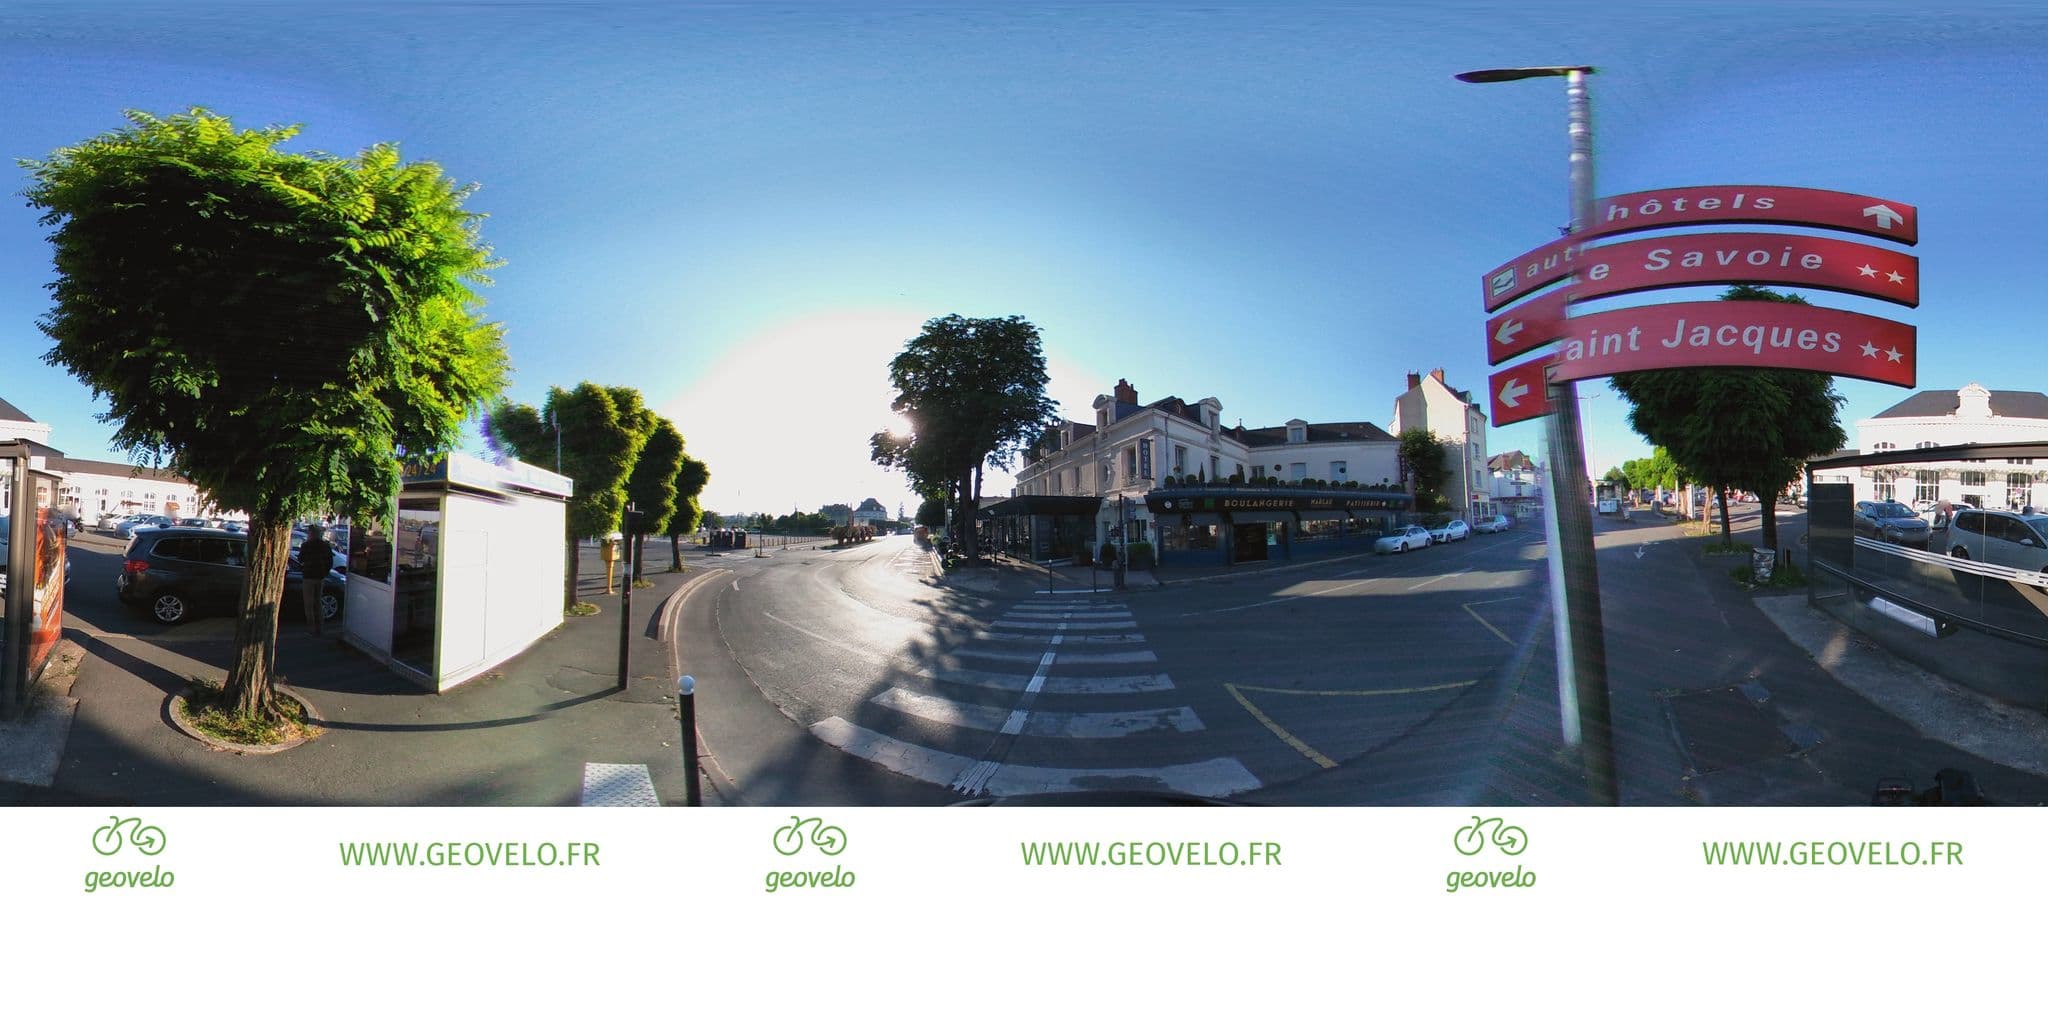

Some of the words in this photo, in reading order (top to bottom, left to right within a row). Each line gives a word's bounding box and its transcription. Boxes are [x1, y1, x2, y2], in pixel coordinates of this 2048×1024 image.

[1607, 193, 1775, 222] hôtels
[1589, 262, 1610, 281] e
[1644, 246, 1824, 271] Savoie
[1564, 325, 1641, 361] aint
[1661, 319, 1842, 355] Jacques
[1224, 499, 1294, 507] BOULANGERIE
